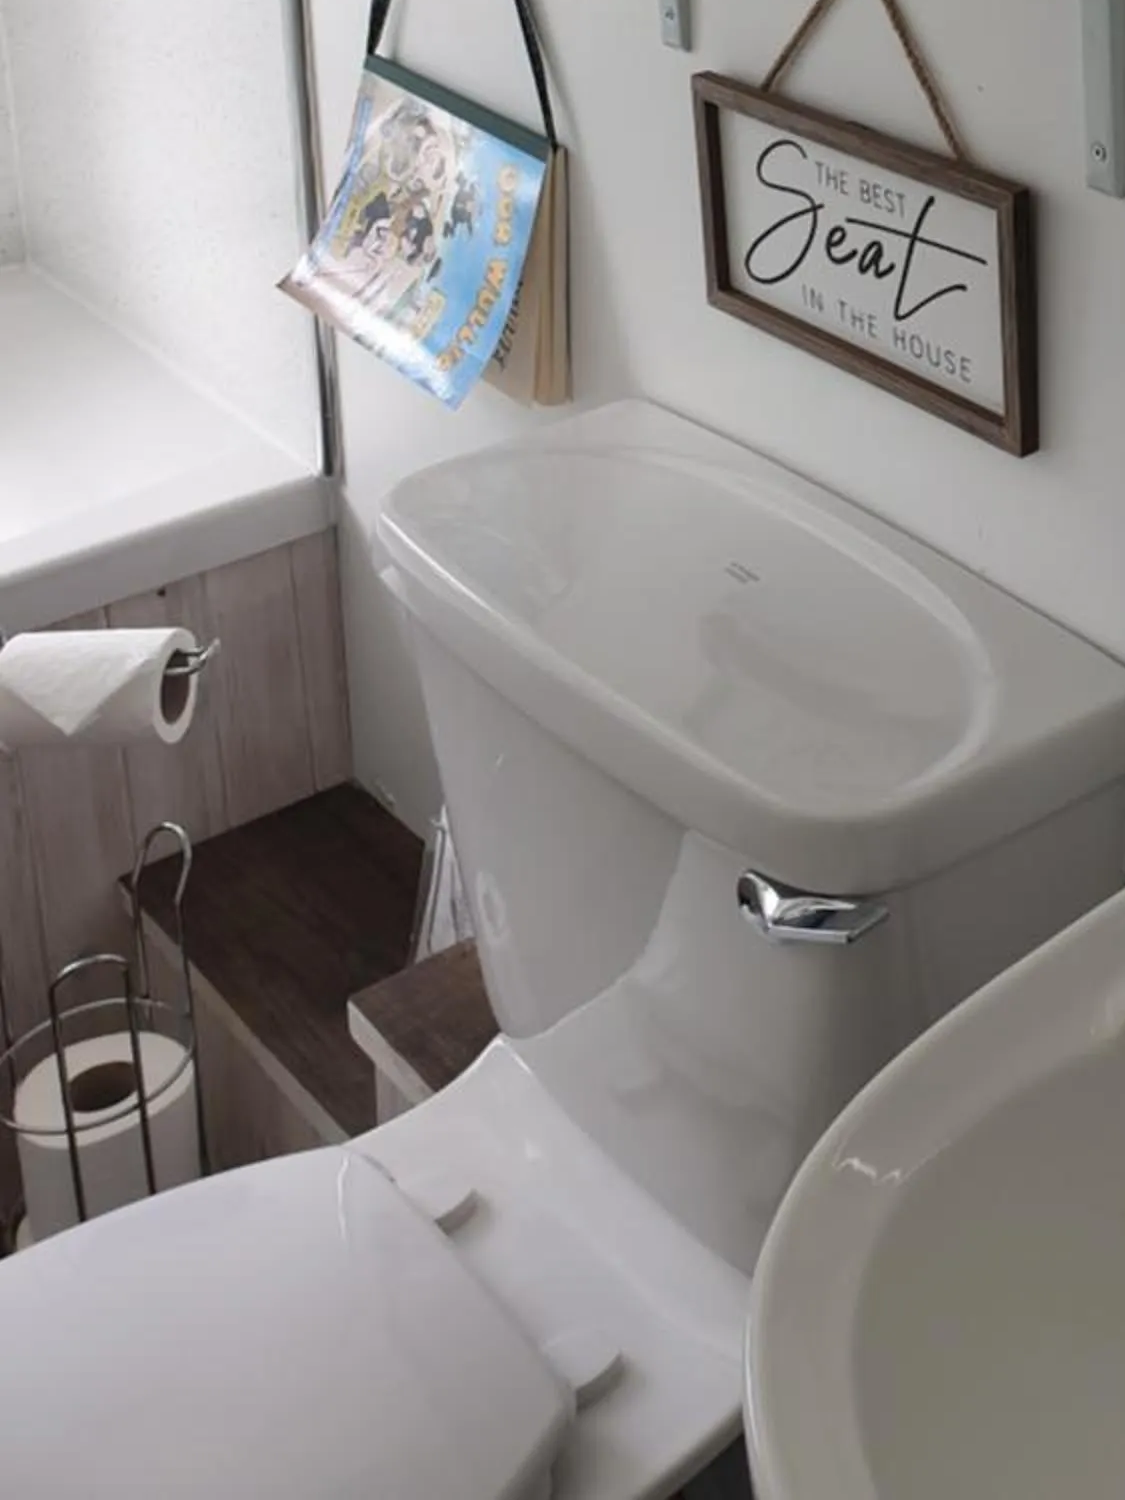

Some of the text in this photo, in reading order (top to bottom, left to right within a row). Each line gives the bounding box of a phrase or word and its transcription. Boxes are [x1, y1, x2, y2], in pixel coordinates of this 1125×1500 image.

[744, 138, 988, 321] Seat
[813, 160, 906, 219] THE BEST
[801, 284, 973, 384] IN THE HOUSE
